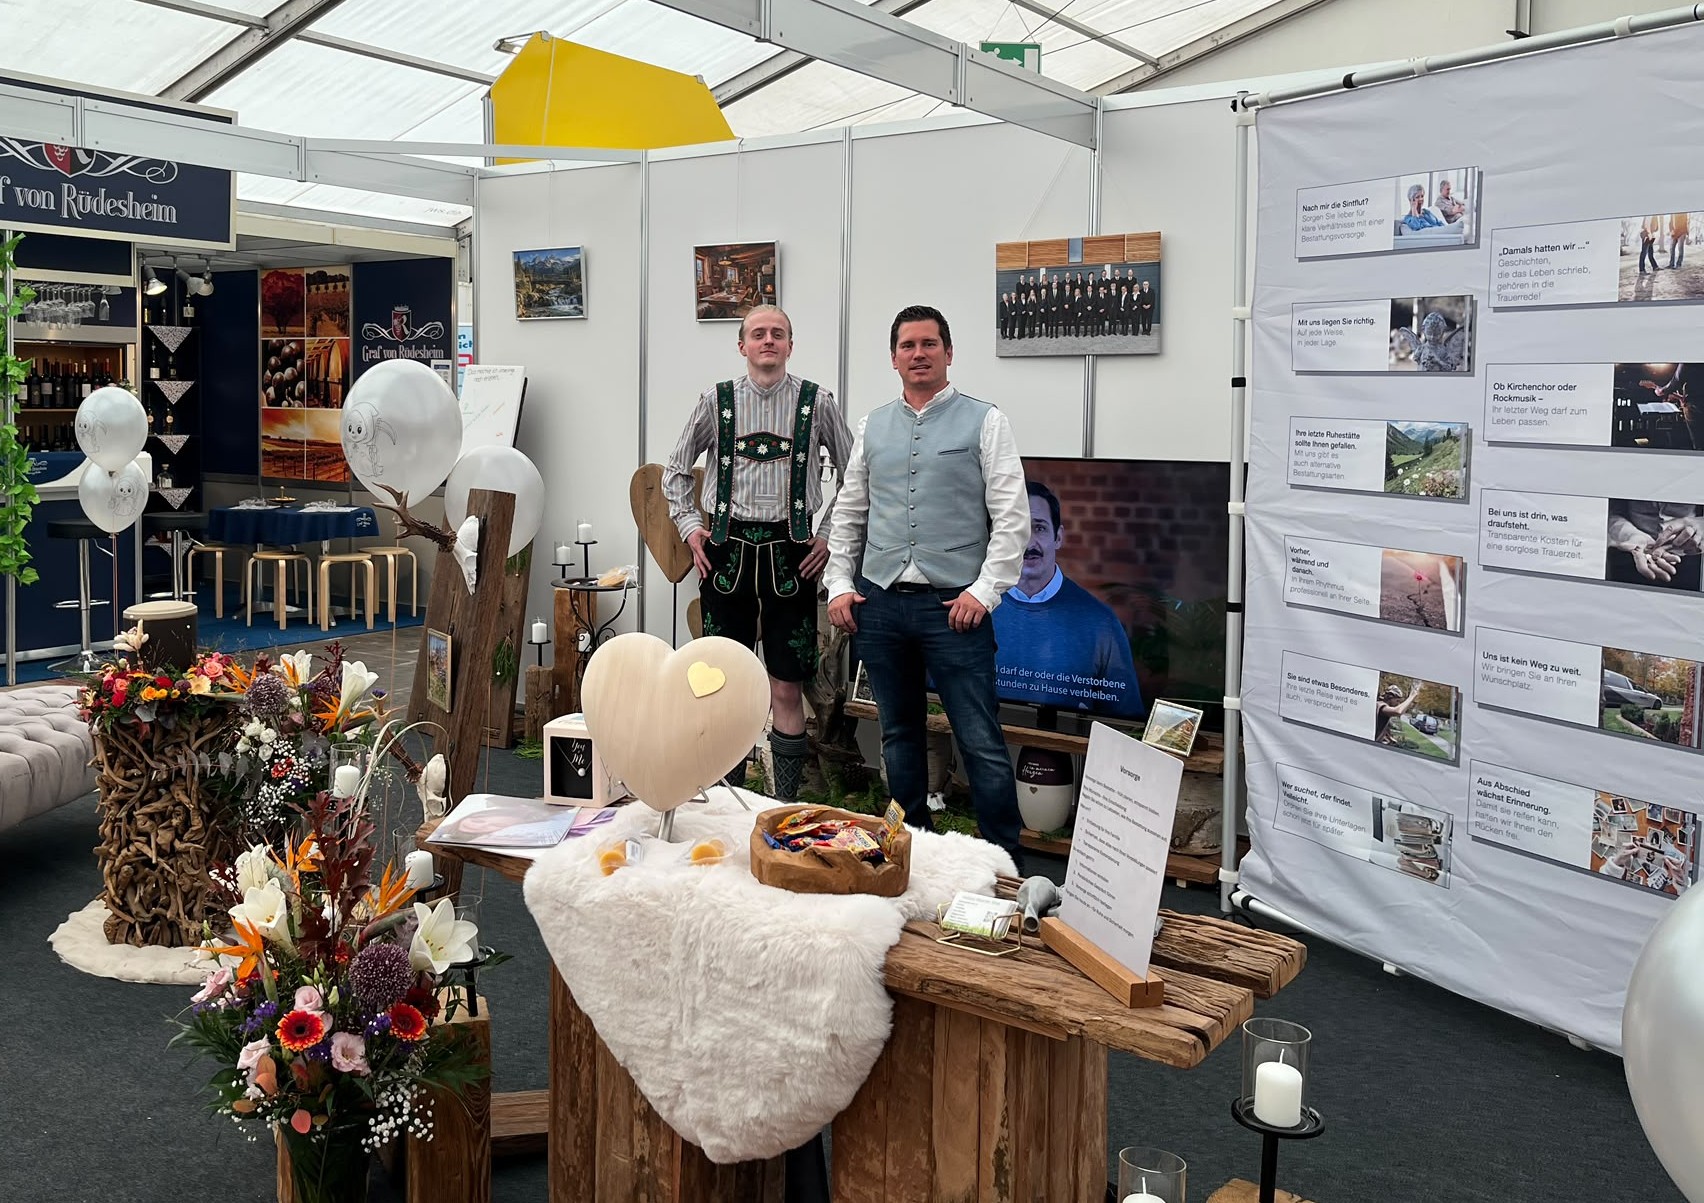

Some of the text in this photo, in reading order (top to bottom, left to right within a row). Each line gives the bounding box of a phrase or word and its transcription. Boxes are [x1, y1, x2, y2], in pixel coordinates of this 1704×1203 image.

[13, 186, 55, 210] von
[60, 182, 177, 223] Rüdesheim
[1342, 198, 1368, 207] Sintflut?
[1318, 222, 1354, 230] Verhältnisse
[1499, 246, 1532, 256] „Damals
[1535, 244, 1560, 253] hatten
[1498, 257, 1551, 267] Geschichten,
[1530, 269, 1554, 277] Leben
[1558, 266, 1590, 275] schrieb,
[1497, 282, 1529, 292] gehören
[1497, 292, 1541, 302] Trauerrede!
[1354, 317, 1375, 325] richtig.
[362, 345, 444, 362] Graf von Rüdesheim
[1493, 394, 1536, 402] Rockmusik
[1504, 406, 1528, 414] letzter
[1531, 406, 1548, 416] Weg
[1551, 407, 1567, 415] darf
[1492, 416, 1516, 425] Leben
[1326, 431, 1360, 439] Ruhestätte
[1310, 461, 1341, 469] alternative
[1531, 512, 1549, 521] drin,
[1488, 520, 1530, 530] draufsteht.
[1488, 530, 1583, 547] Transparente Kosten für
[1290, 546, 1310, 556] Vorher,
[1505, 545, 1539, 554] sorglose
[1542, 548, 1583, 559] Trauerzeit.
[1291, 557, 1315, 566] während
[1292, 567, 1314, 575] danach.
[1483, 651, 1497, 661] Uns
[1512, 656, 1527, 666] kein
[1530, 660, 1548, 671] Weg
[1562, 667, 1581, 676] weit.
[1000, 666, 1017, 675] darf
[1019, 668, 1033, 677] der
[1035, 670, 1054, 680] oder
[1057, 673, 1070, 682] die
[1072, 674, 1126, 689] Verstorbene
[1482, 662, 1494, 670] Wir
[1497, 666, 1525, 677] bringen
[1528, 671, 1541, 680] Sie
[1557, 677, 1576, 687] Ihren
[1042, 684, 1068, 695] Hause
[1070, 688, 1119, 702] verbleiben.
[1312, 679, 1329, 688] etwas
[1331, 683, 1370, 698] Besonderes.
[1316, 689, 1333, 699] Reise
[1120, 765, 1140, 781] Vorsorge
[1477, 777, 1530, 797] Aus Abschied
[1282, 781, 1352, 808] Wer suchet, der findet.
[1476, 799, 1498, 812] Damit
[1477, 789, 1551, 815] wächst Erinnerung.
[1475, 821, 1503, 835] Rücken
[1514, 821, 1535, 833] Ihnen
[1538, 829, 1553, 838] den
